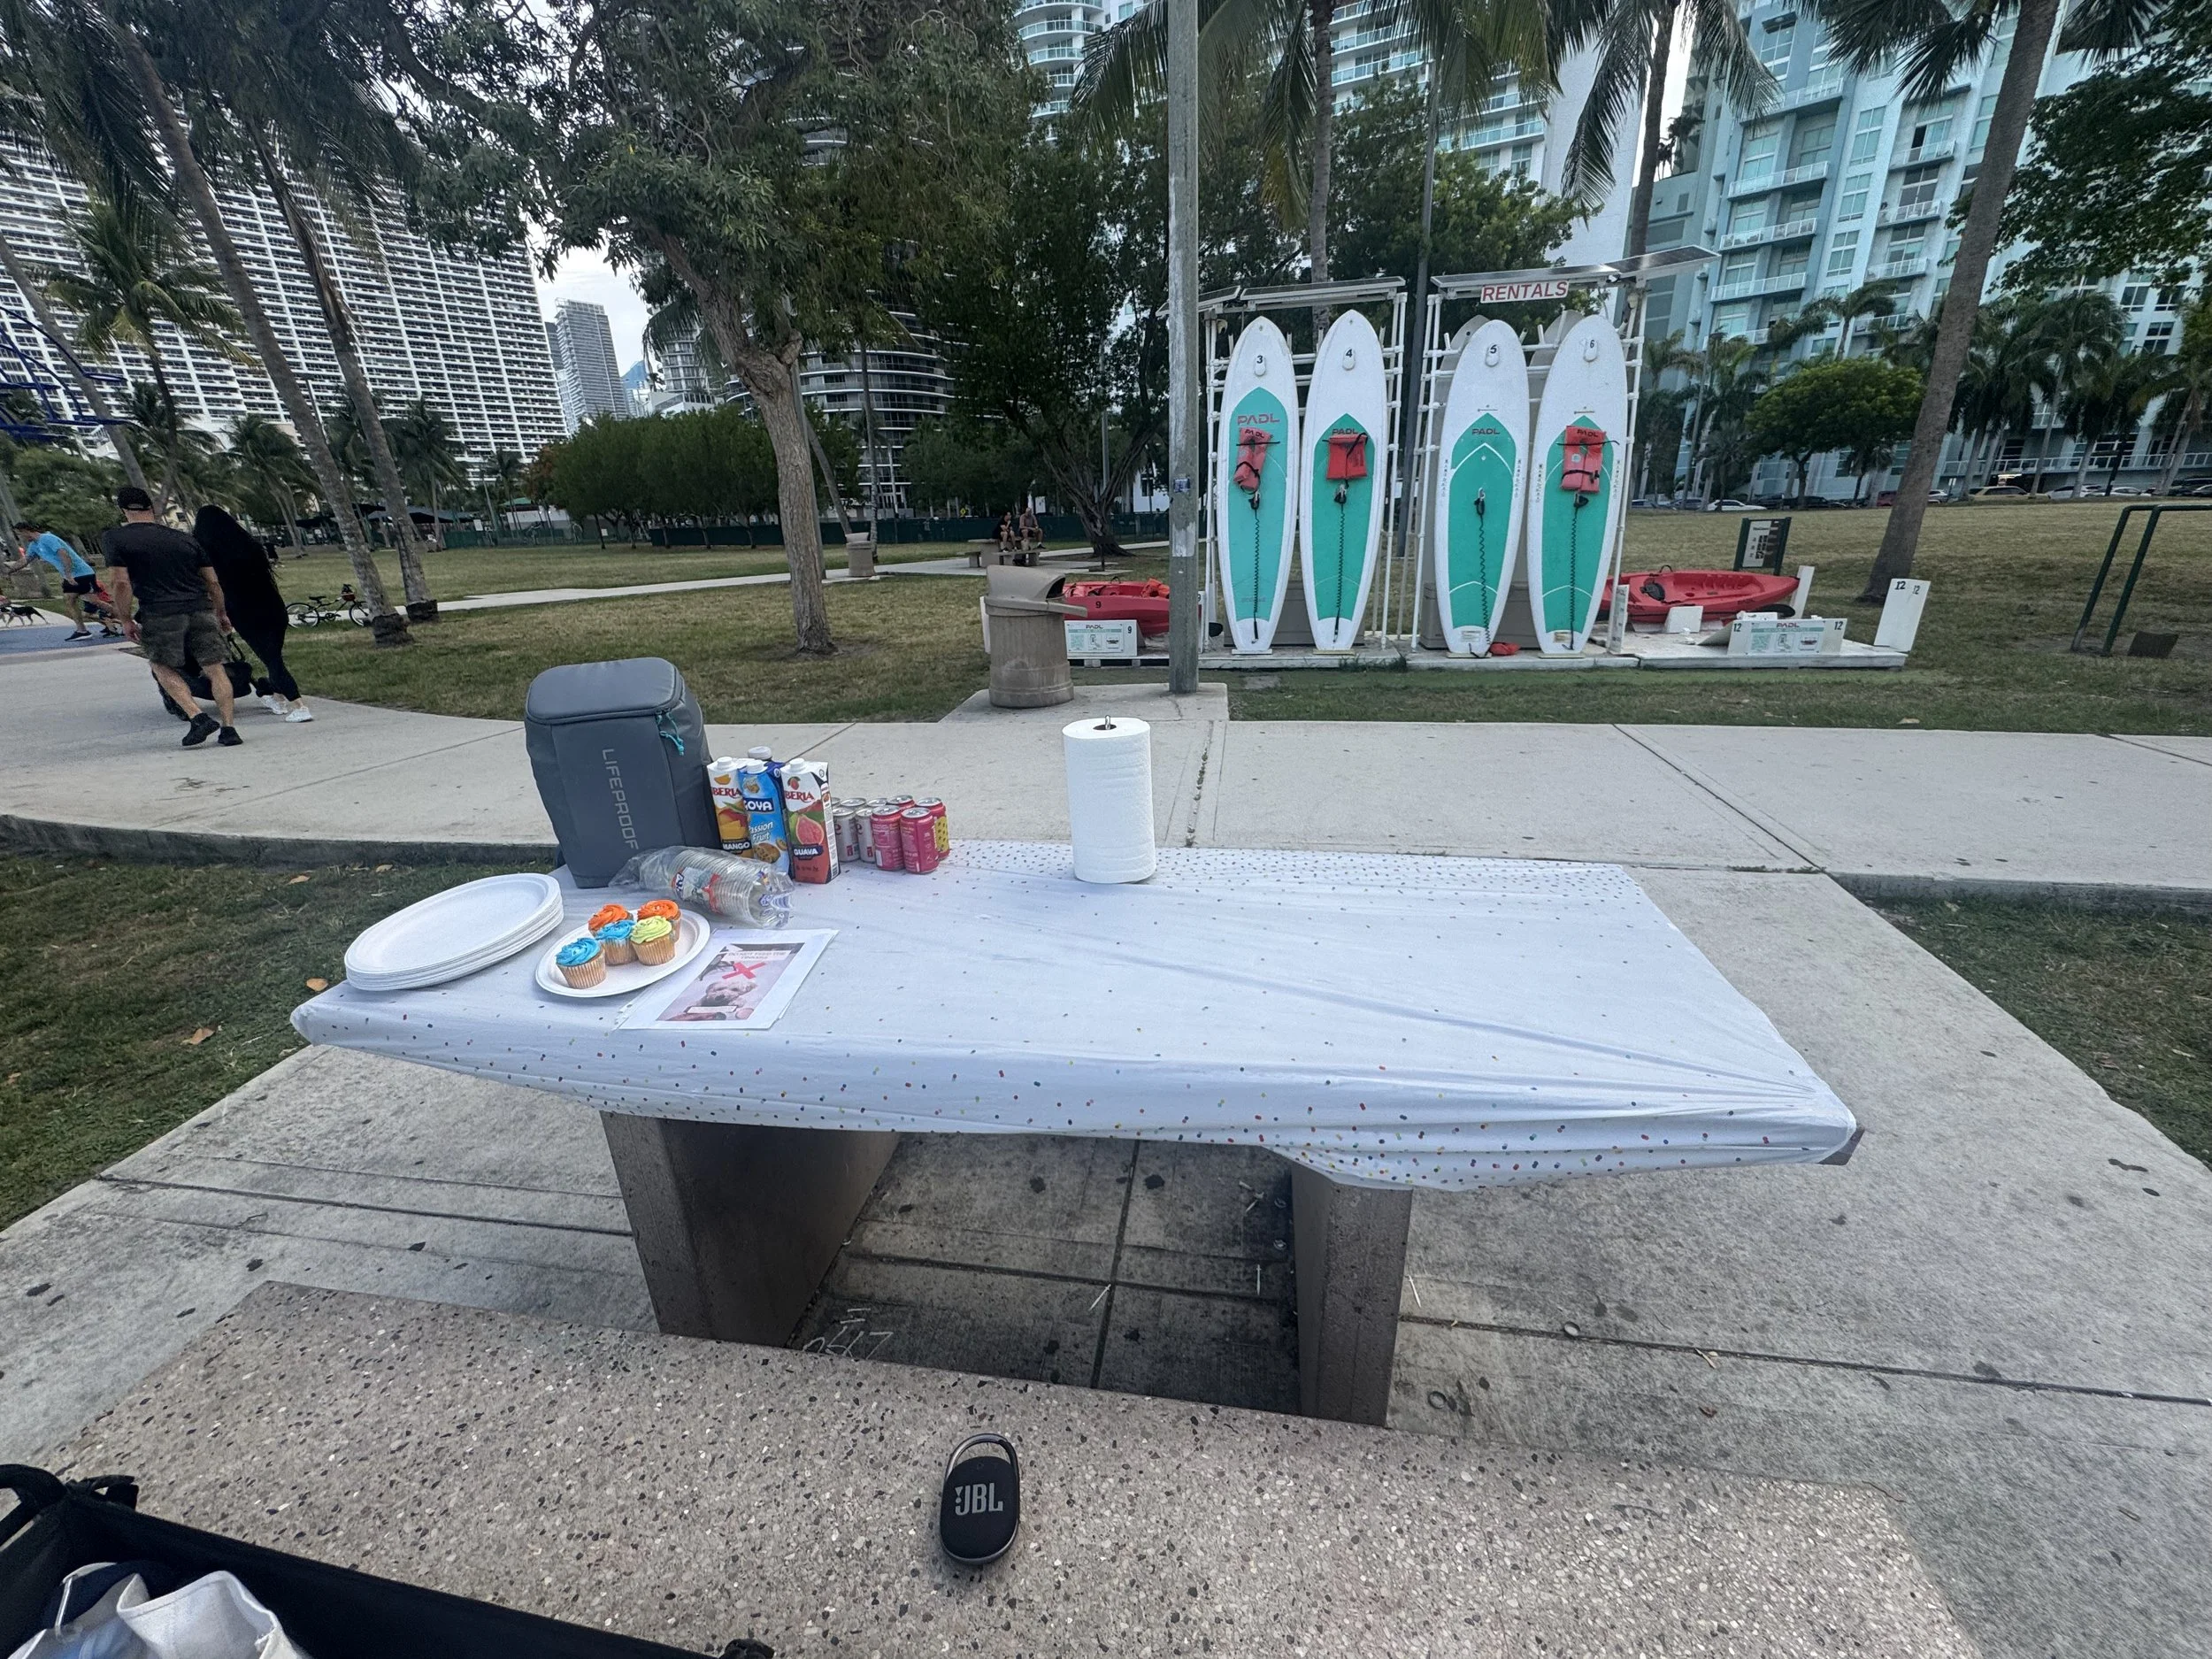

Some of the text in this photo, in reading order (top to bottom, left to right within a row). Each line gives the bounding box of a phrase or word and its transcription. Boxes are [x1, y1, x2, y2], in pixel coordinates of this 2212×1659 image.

[1482, 280, 1568, 302] RENTALS
[1490, 344, 1497, 354] 5
[1589, 339, 1595, 349] 6
[1345, 349, 1353, 358] 4
[1256, 355, 1263, 364] 3
[1237, 412, 1280, 425] PADL
[1894, 580, 1906, 590] 12
[1912, 585, 1921, 595] 12
[1127, 626, 1133, 634] 9
[1733, 623, 1742, 633] 12
[1834, 621, 1844, 631] 12
[712, 787, 742, 799] BERIA
[785, 791, 815, 803] BERIA
[603, 749, 639, 850] LIFEPROOF
[749, 821, 773, 833] assion
[722, 841, 750, 850] MANGO
[955, 1482, 1003, 1517] JBL
